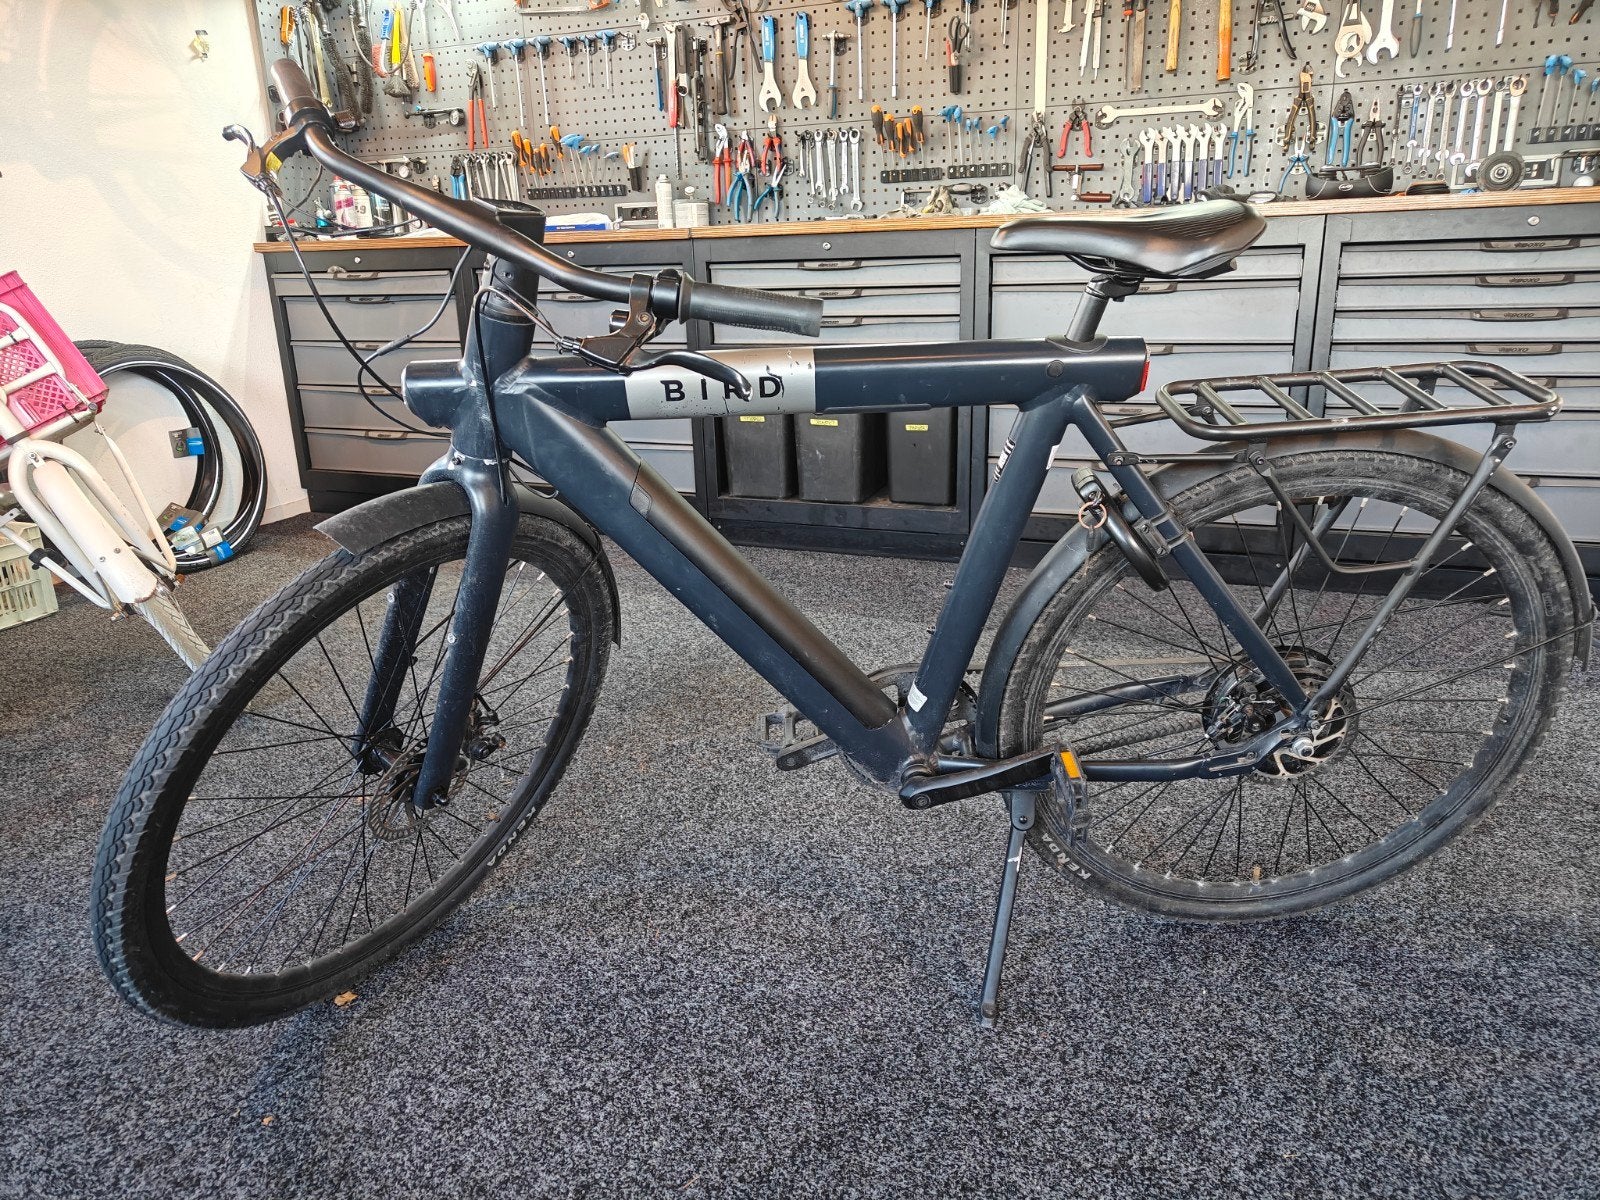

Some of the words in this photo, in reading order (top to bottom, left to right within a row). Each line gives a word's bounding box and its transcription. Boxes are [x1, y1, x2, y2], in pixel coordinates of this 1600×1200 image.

[660, 376, 782, 402] BIRD
[487, 806, 536, 867] KENDA
[1042, 833, 1091, 880] KENDA
